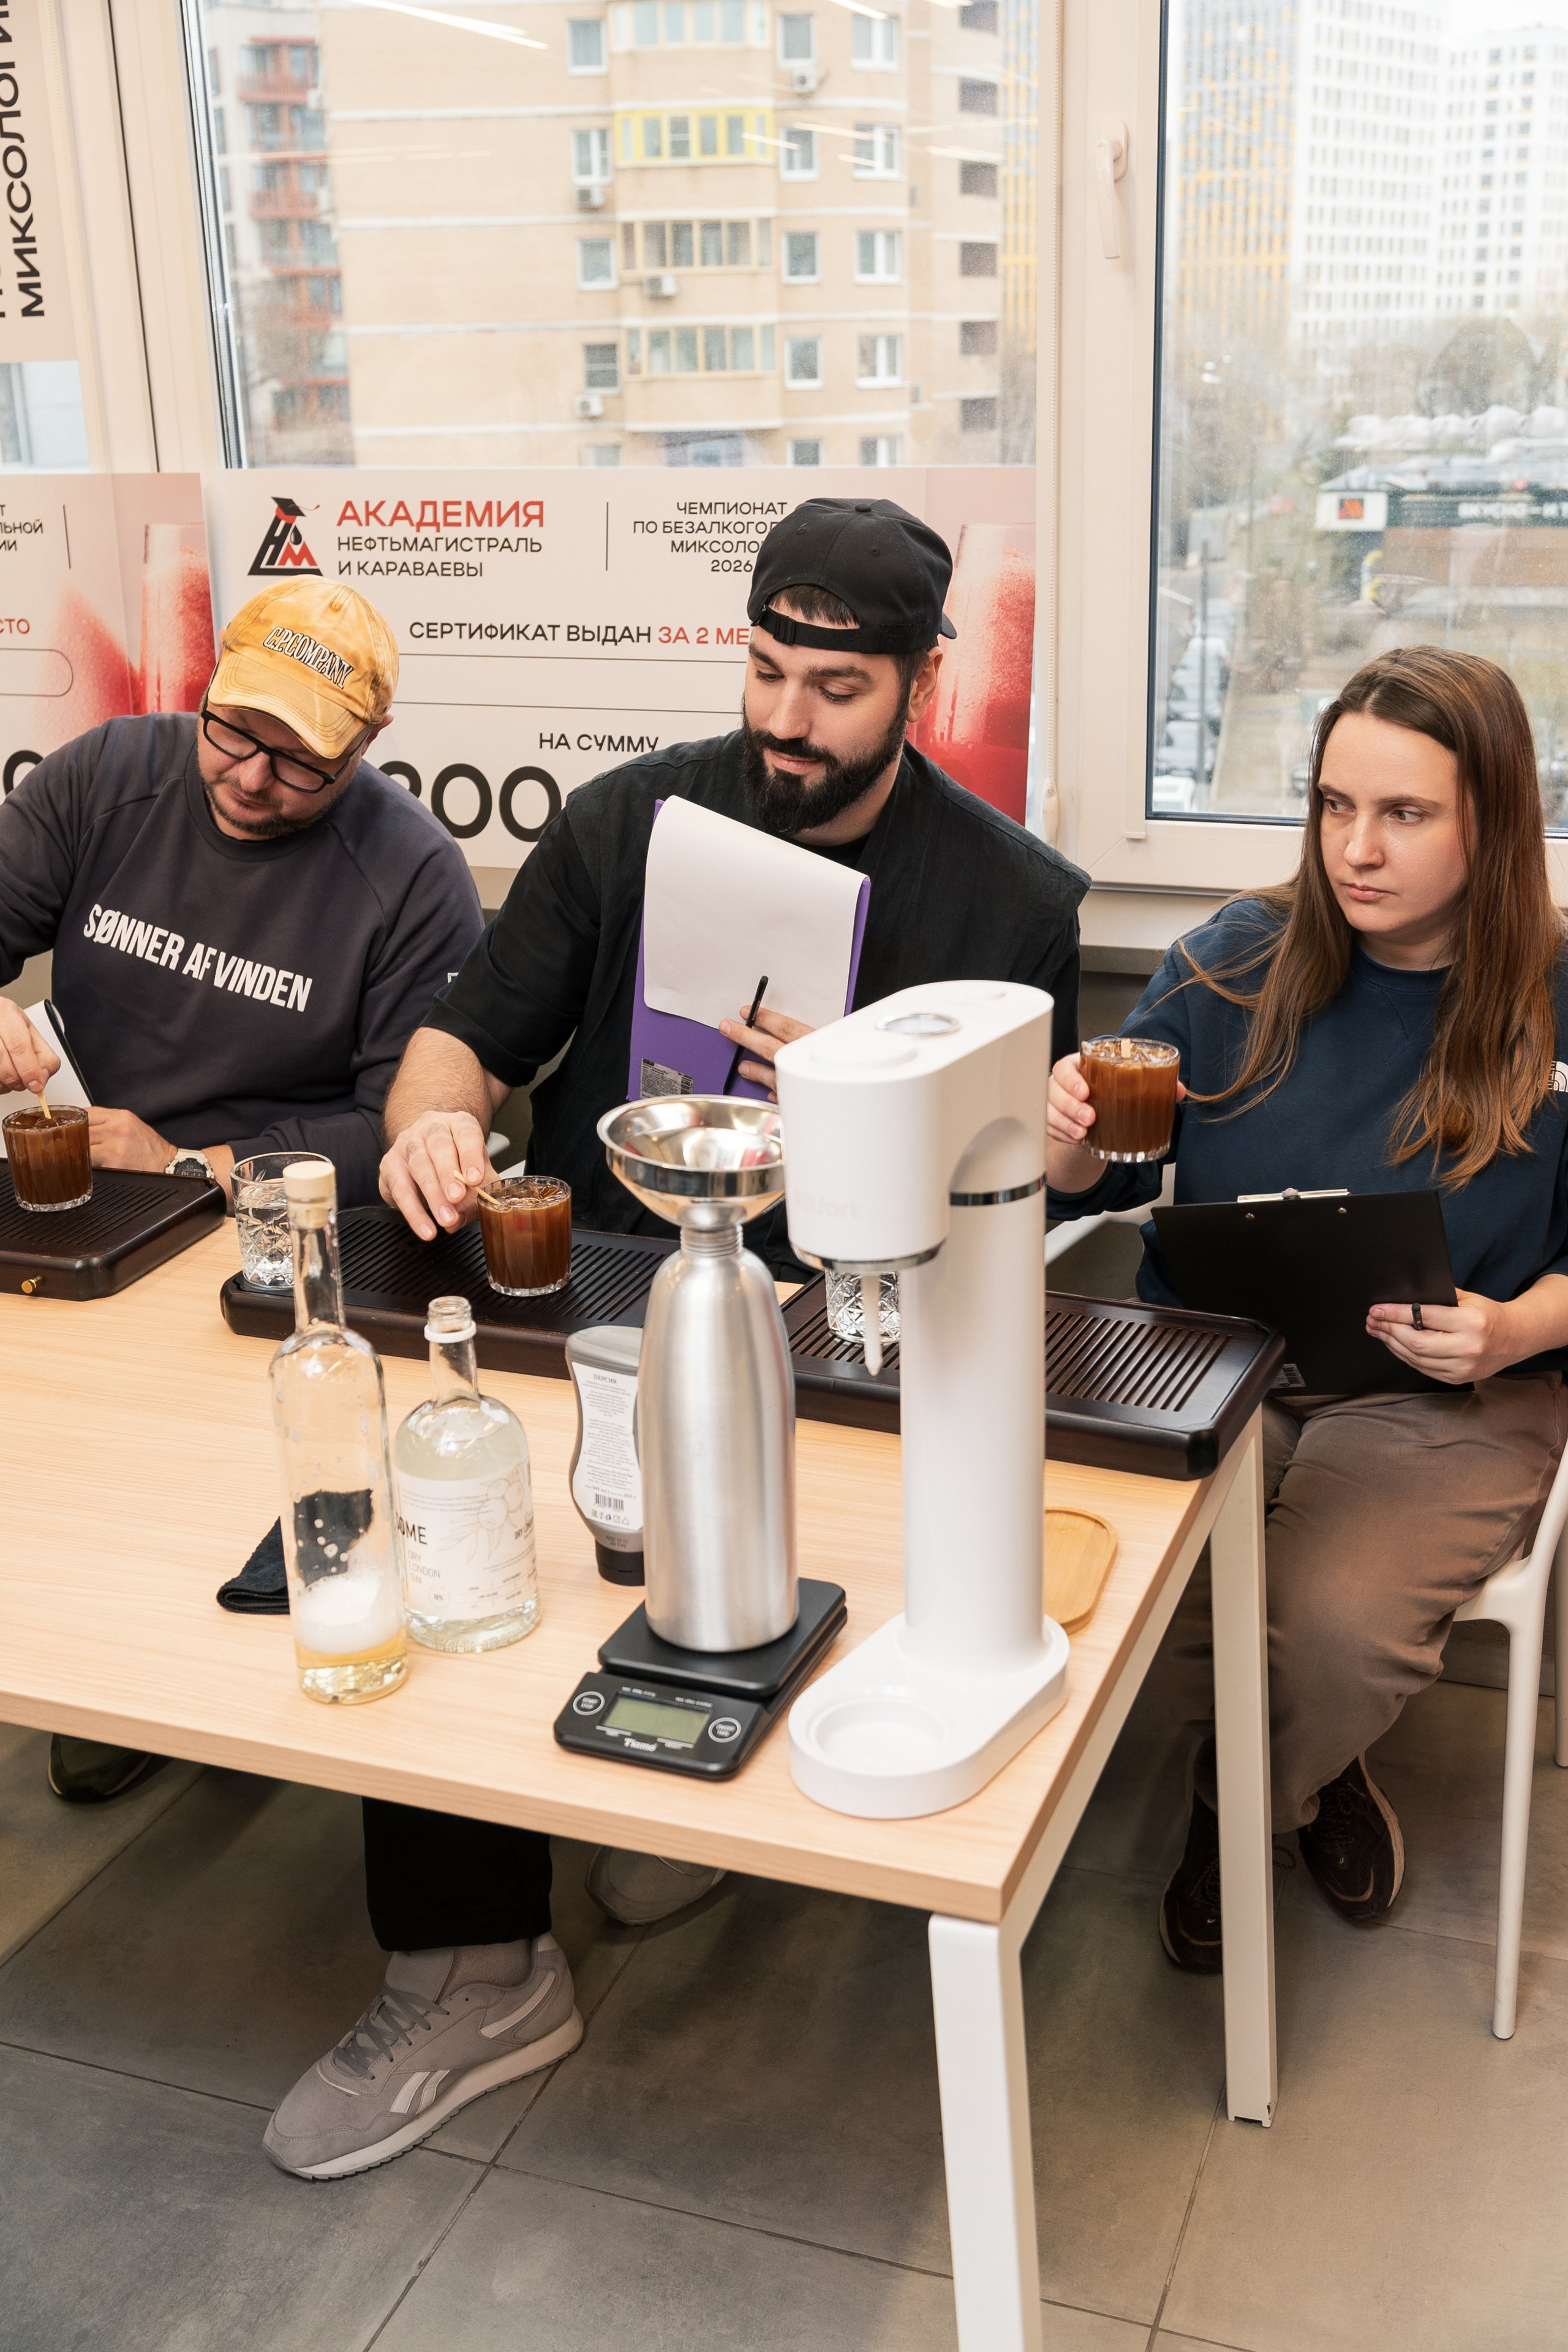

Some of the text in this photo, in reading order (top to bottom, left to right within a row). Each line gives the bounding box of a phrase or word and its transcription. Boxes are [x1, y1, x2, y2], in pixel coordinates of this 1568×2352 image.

[676, 502, 788, 514] ЧЕМПИОНАТ
[336, 500, 543, 532] АКАДЕМИЯ
[633, 521, 658, 533] ПО
[337, 537, 542, 552] НЕФТЬМАГИСТРАЛЬ
[671, 540, 764, 553] МИКСОЛО
[338, 560, 483, 576] И КАРАВАЕВЫ
[710, 559, 753, 572] 2026
[409, 622, 749, 646] СЕРТИФИКАТ ВЫДАН ЗА 2 МЕ
[539, 733, 660, 753] НА СУММУ
[83, 904, 313, 1012] SØNNER AF VINDEN
[593, 1374, 617, 1384] ПЕРСИК
[408, 1550, 421, 1561] DRY
[409, 1563, 440, 1578] LONDON
